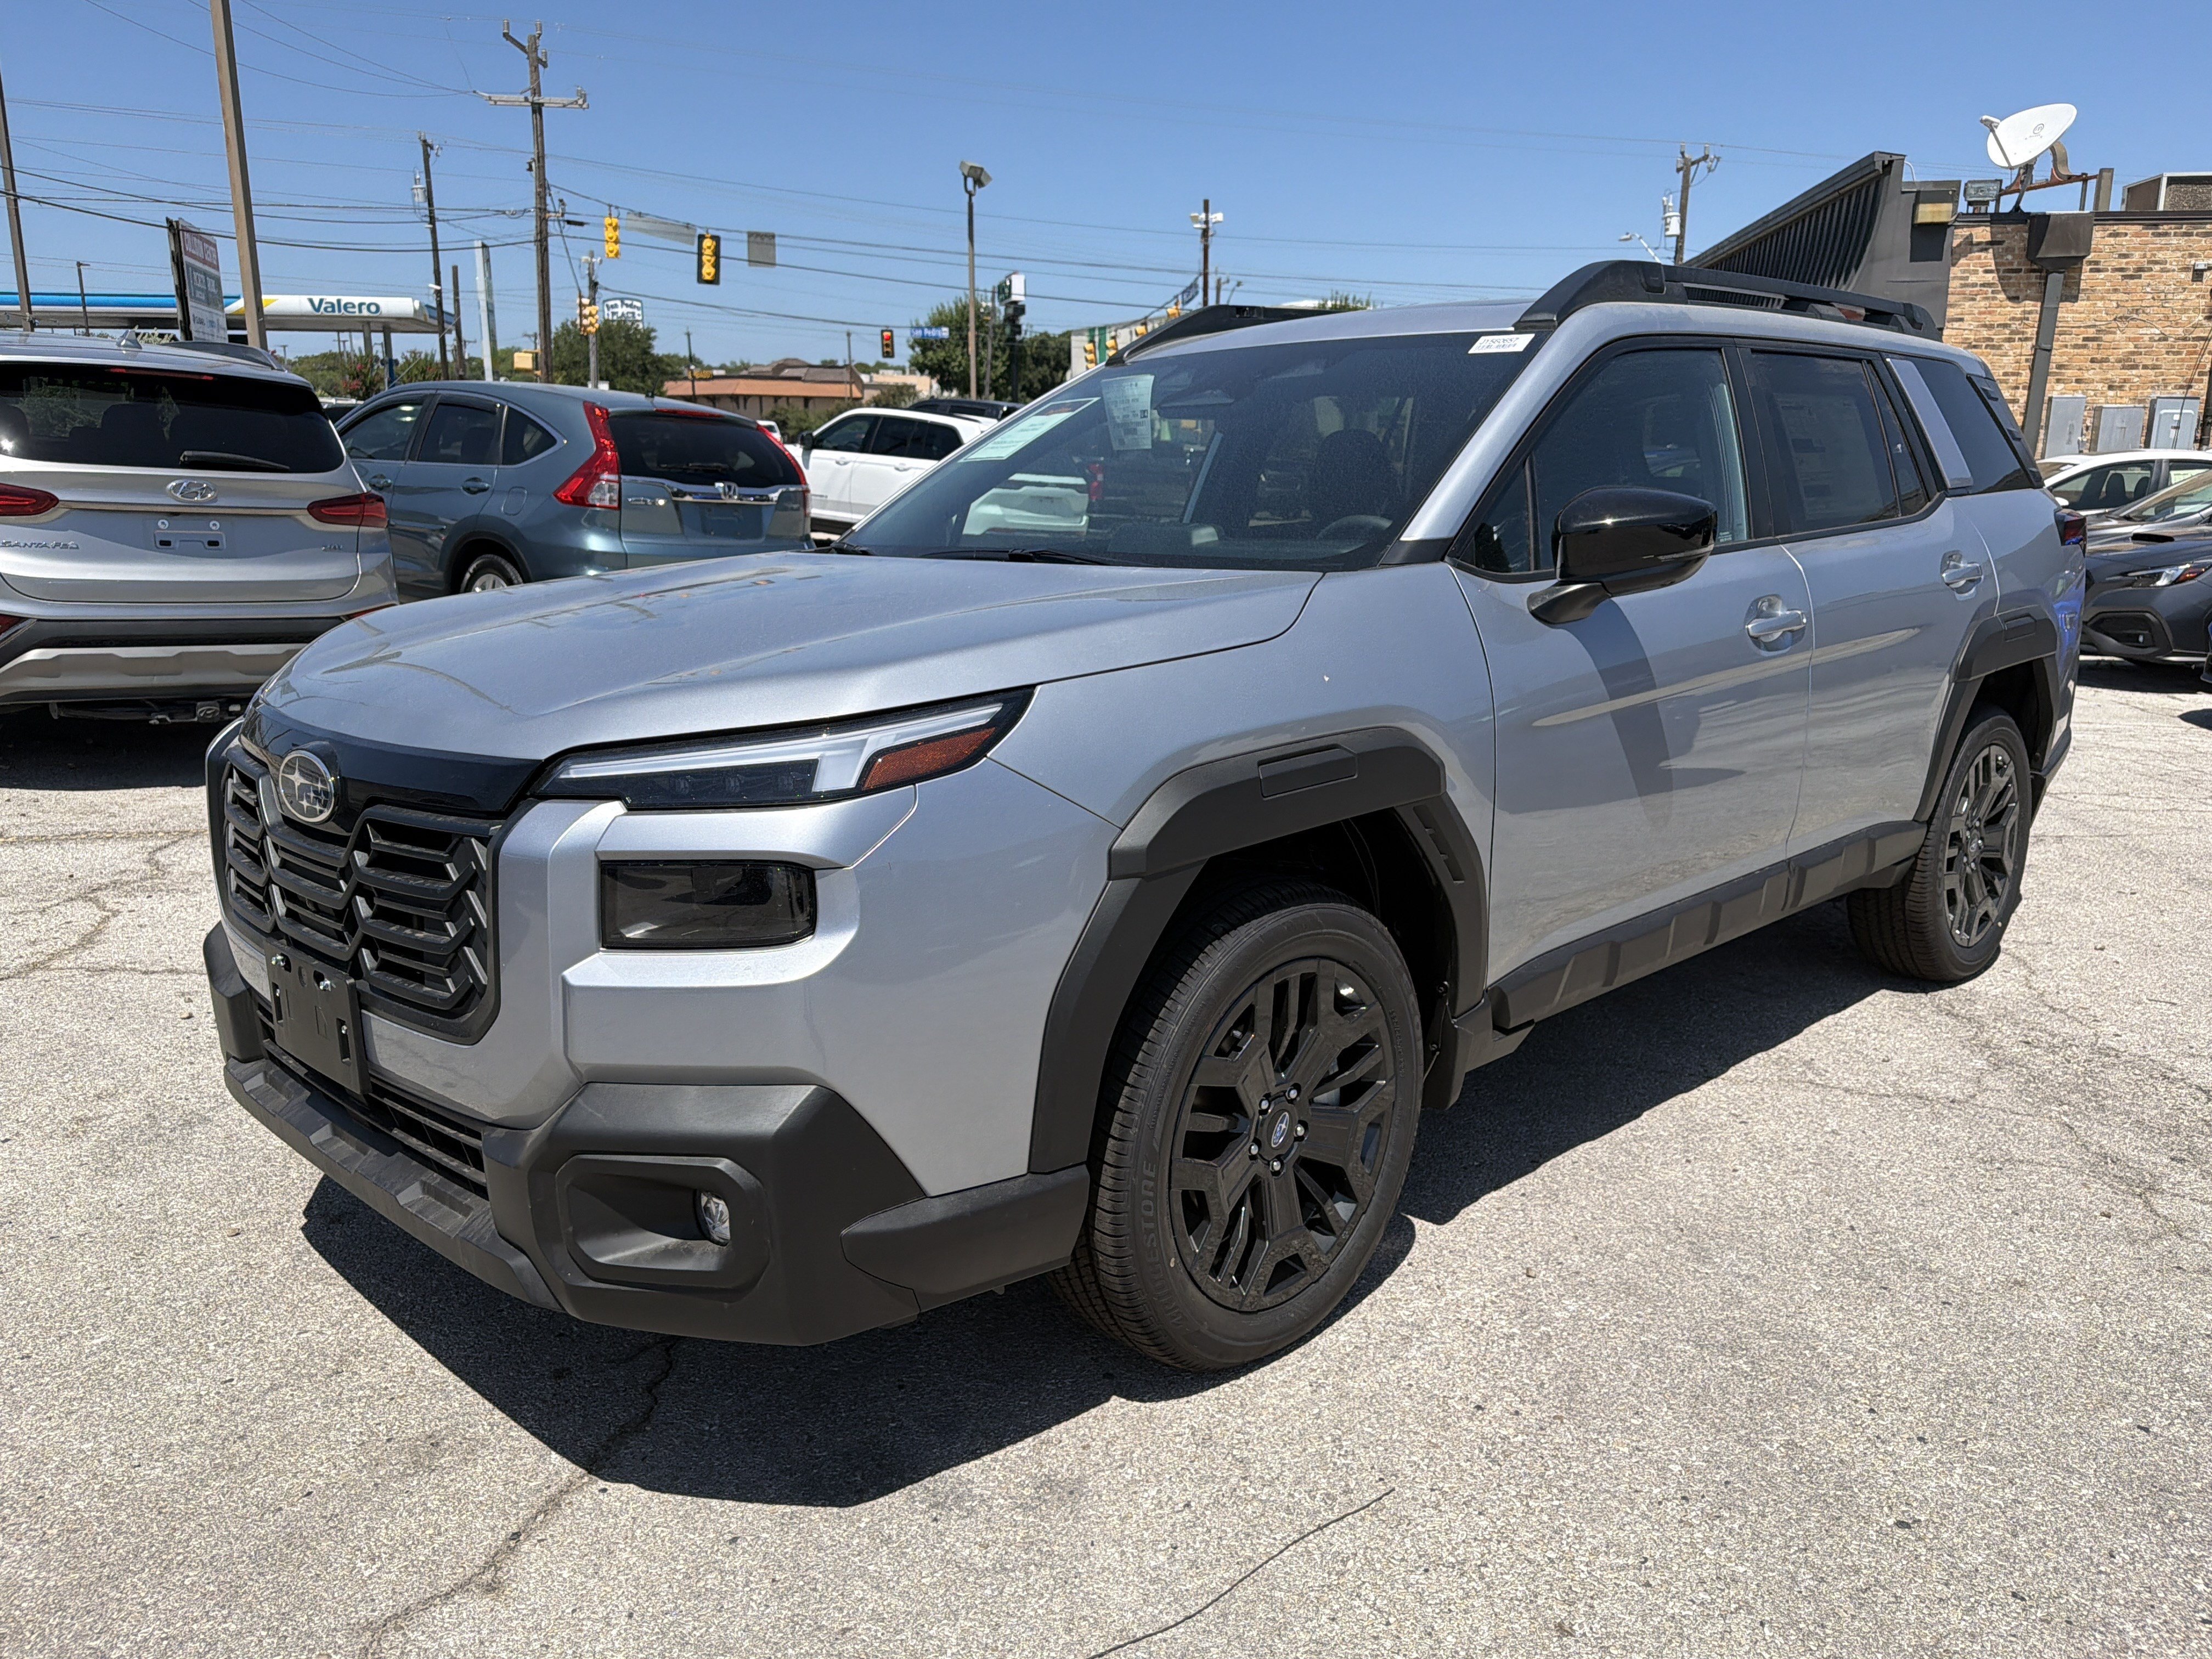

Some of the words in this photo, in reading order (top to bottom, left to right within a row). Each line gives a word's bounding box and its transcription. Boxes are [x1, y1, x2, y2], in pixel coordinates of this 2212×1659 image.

[307, 297, 381, 314] Valero
[620, 300, 641, 311] Pedro
[611, 311, 636, 320] PLACE
[0, 539, 50, 548] SANTA
[1141, 1158, 1183, 1331] BRIDGESTONE
